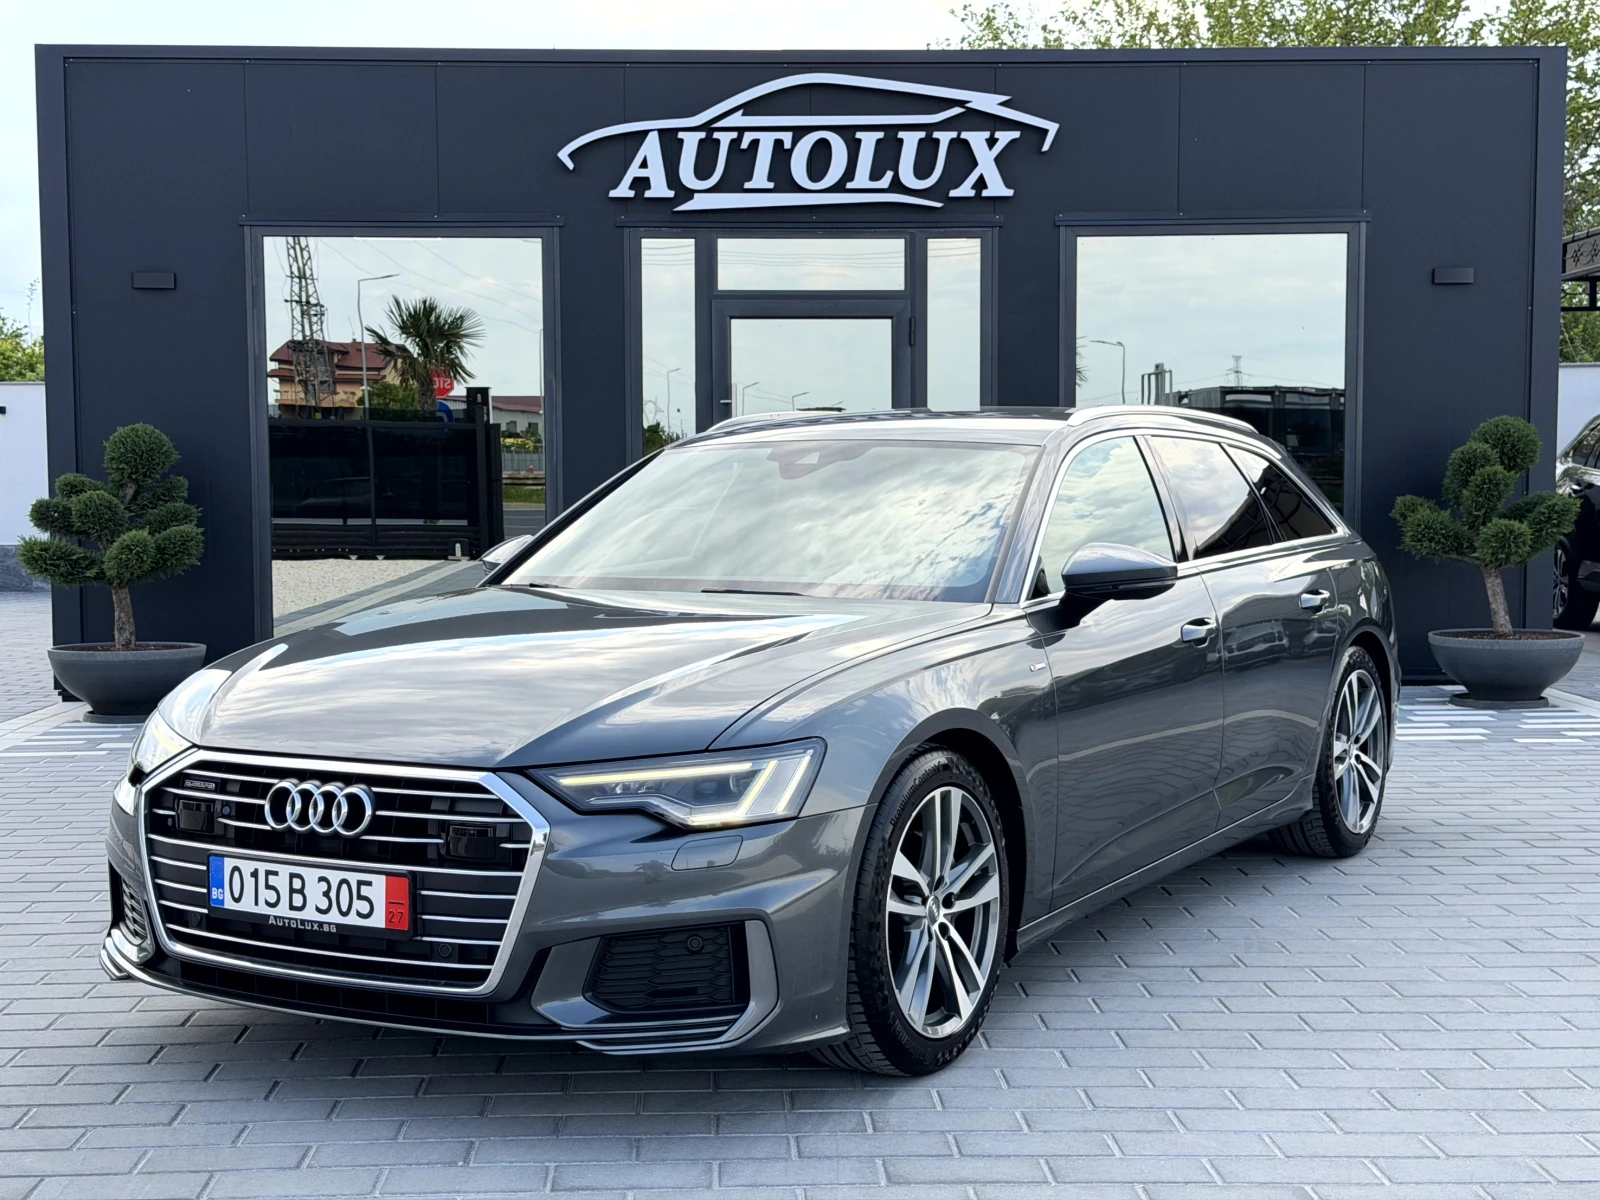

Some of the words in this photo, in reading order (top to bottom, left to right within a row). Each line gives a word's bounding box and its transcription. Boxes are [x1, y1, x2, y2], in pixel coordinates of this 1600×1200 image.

[608, 130, 1021, 198] AUTOLUX
[211, 887, 224, 899] BG
[388, 911, 404, 924] 27
